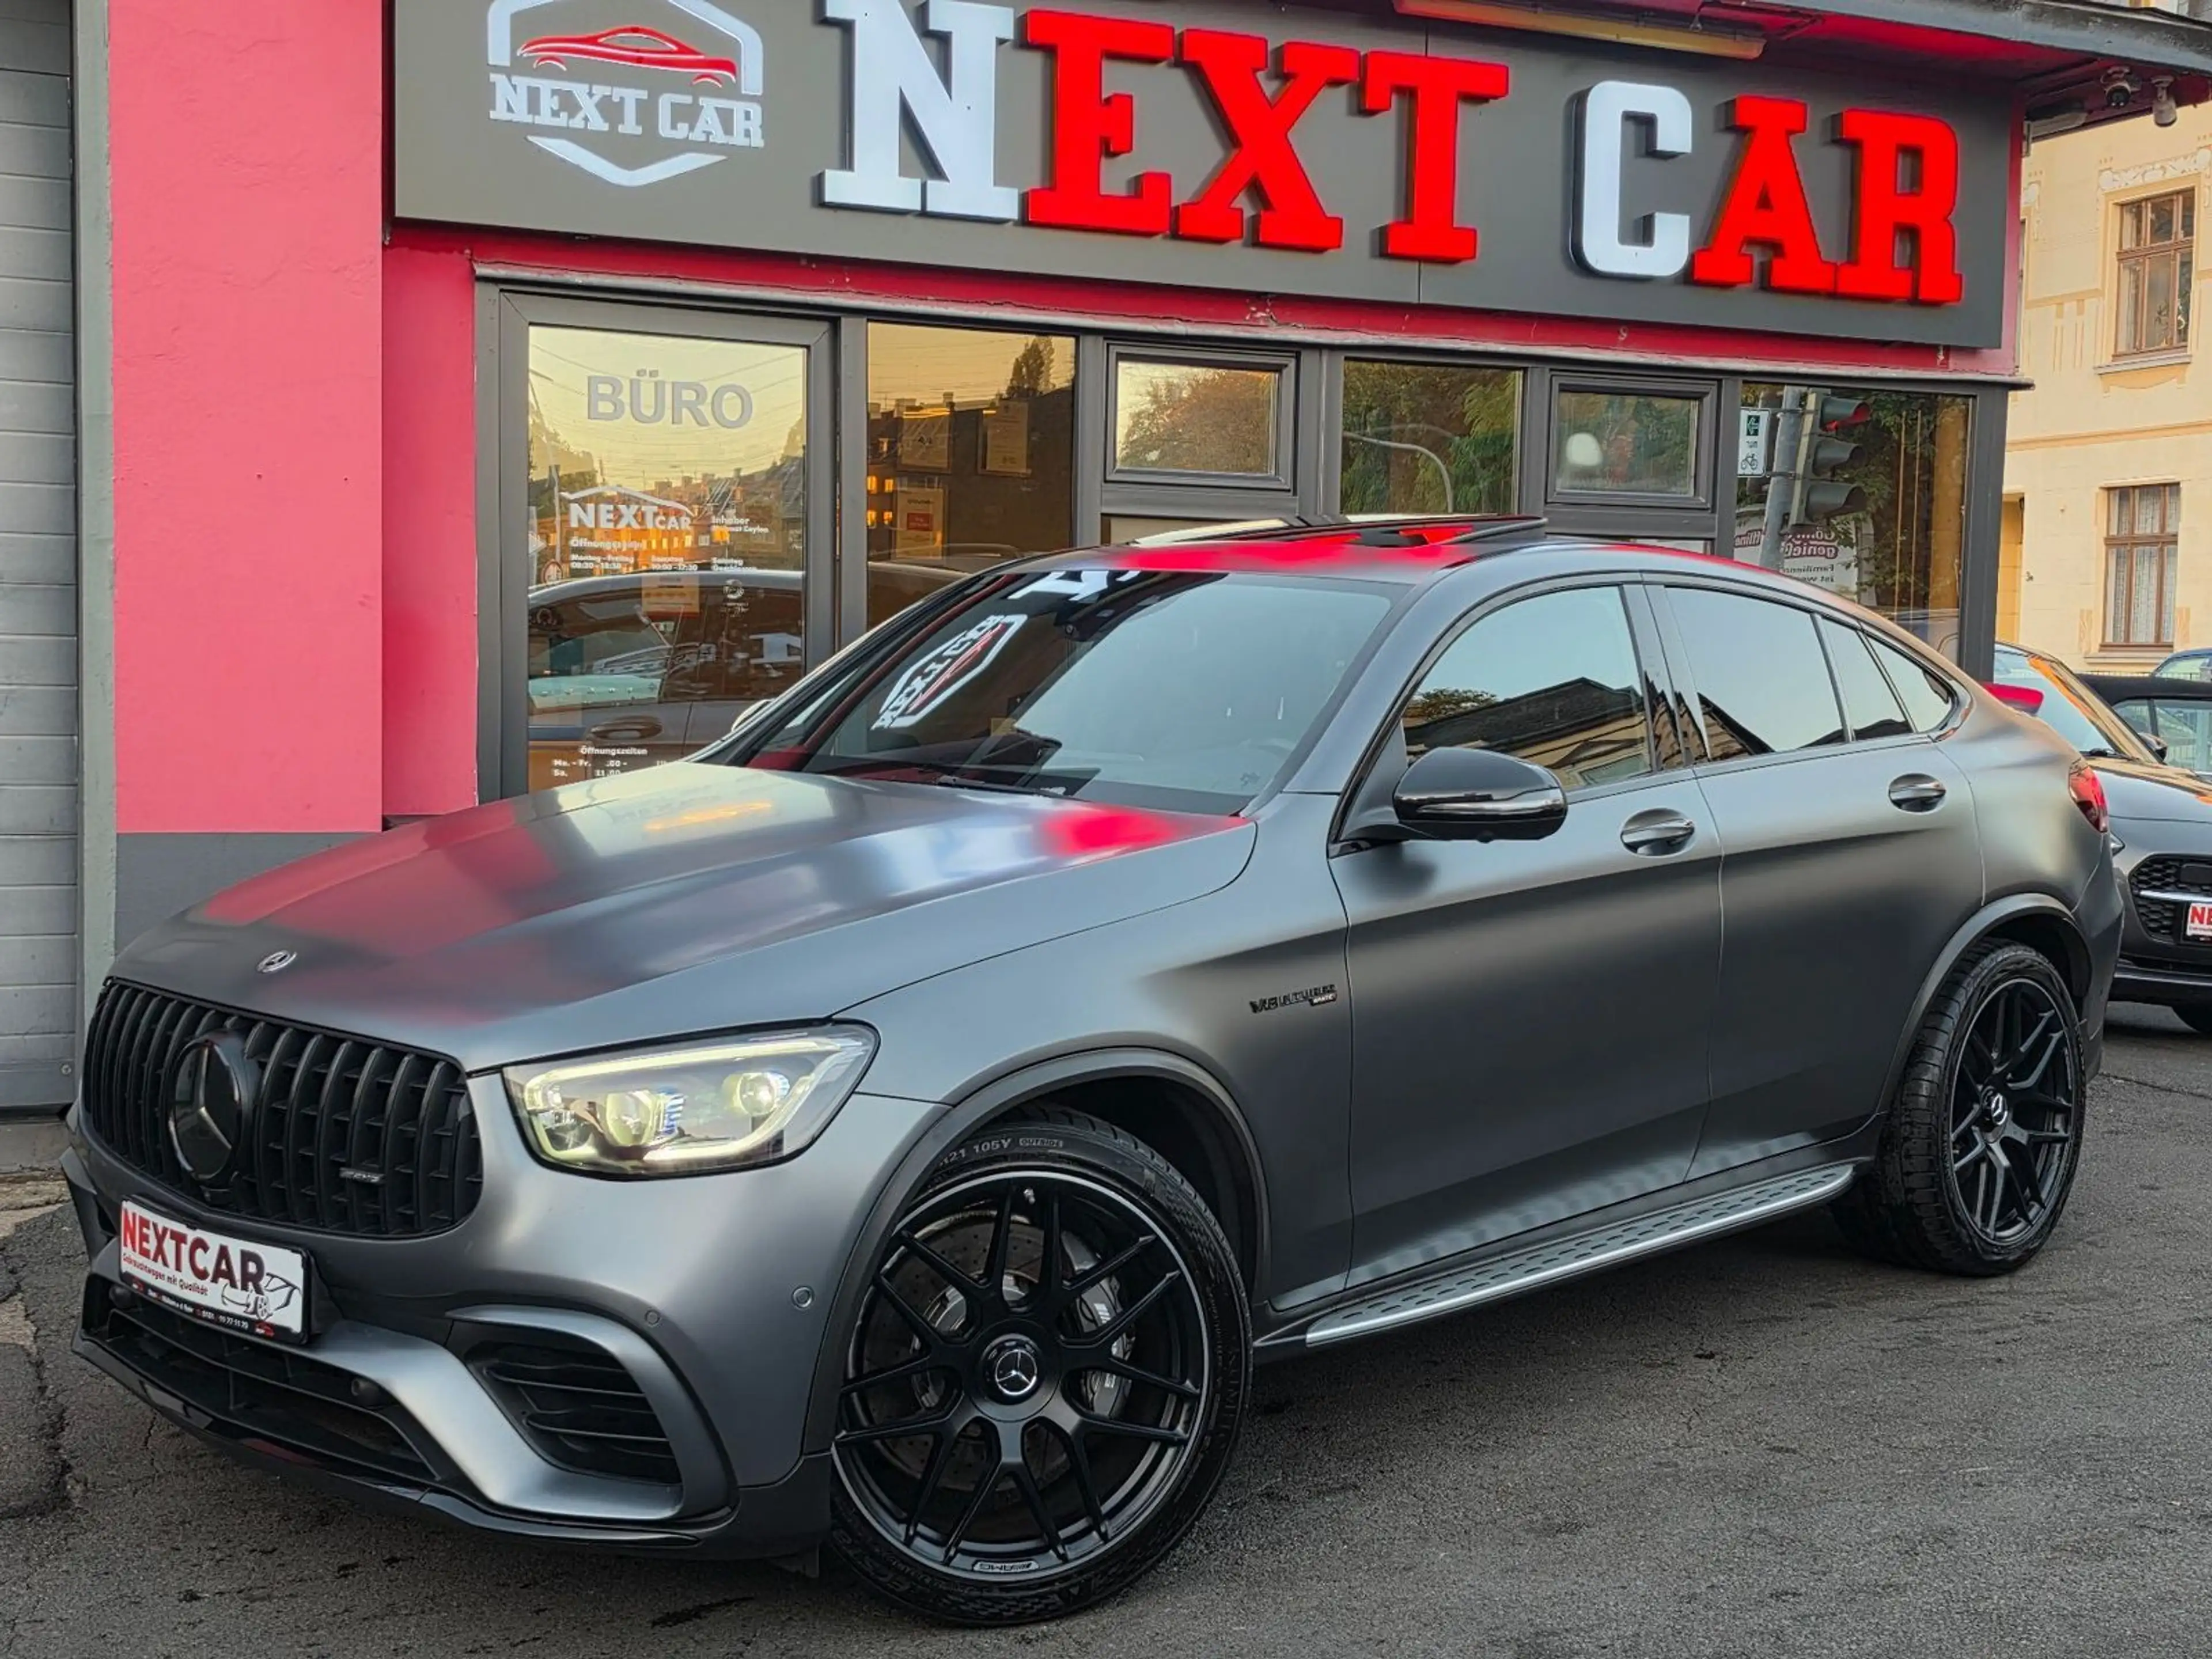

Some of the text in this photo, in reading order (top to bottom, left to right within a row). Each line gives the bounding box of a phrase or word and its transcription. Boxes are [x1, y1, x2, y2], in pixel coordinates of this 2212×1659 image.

[489, 73, 764, 148] NEXT CAR
[820, 0, 1963, 305] NEXT CAR
[588, 369, 753, 429] BÜRO
[123, 1208, 265, 1296] NEXTCAR
